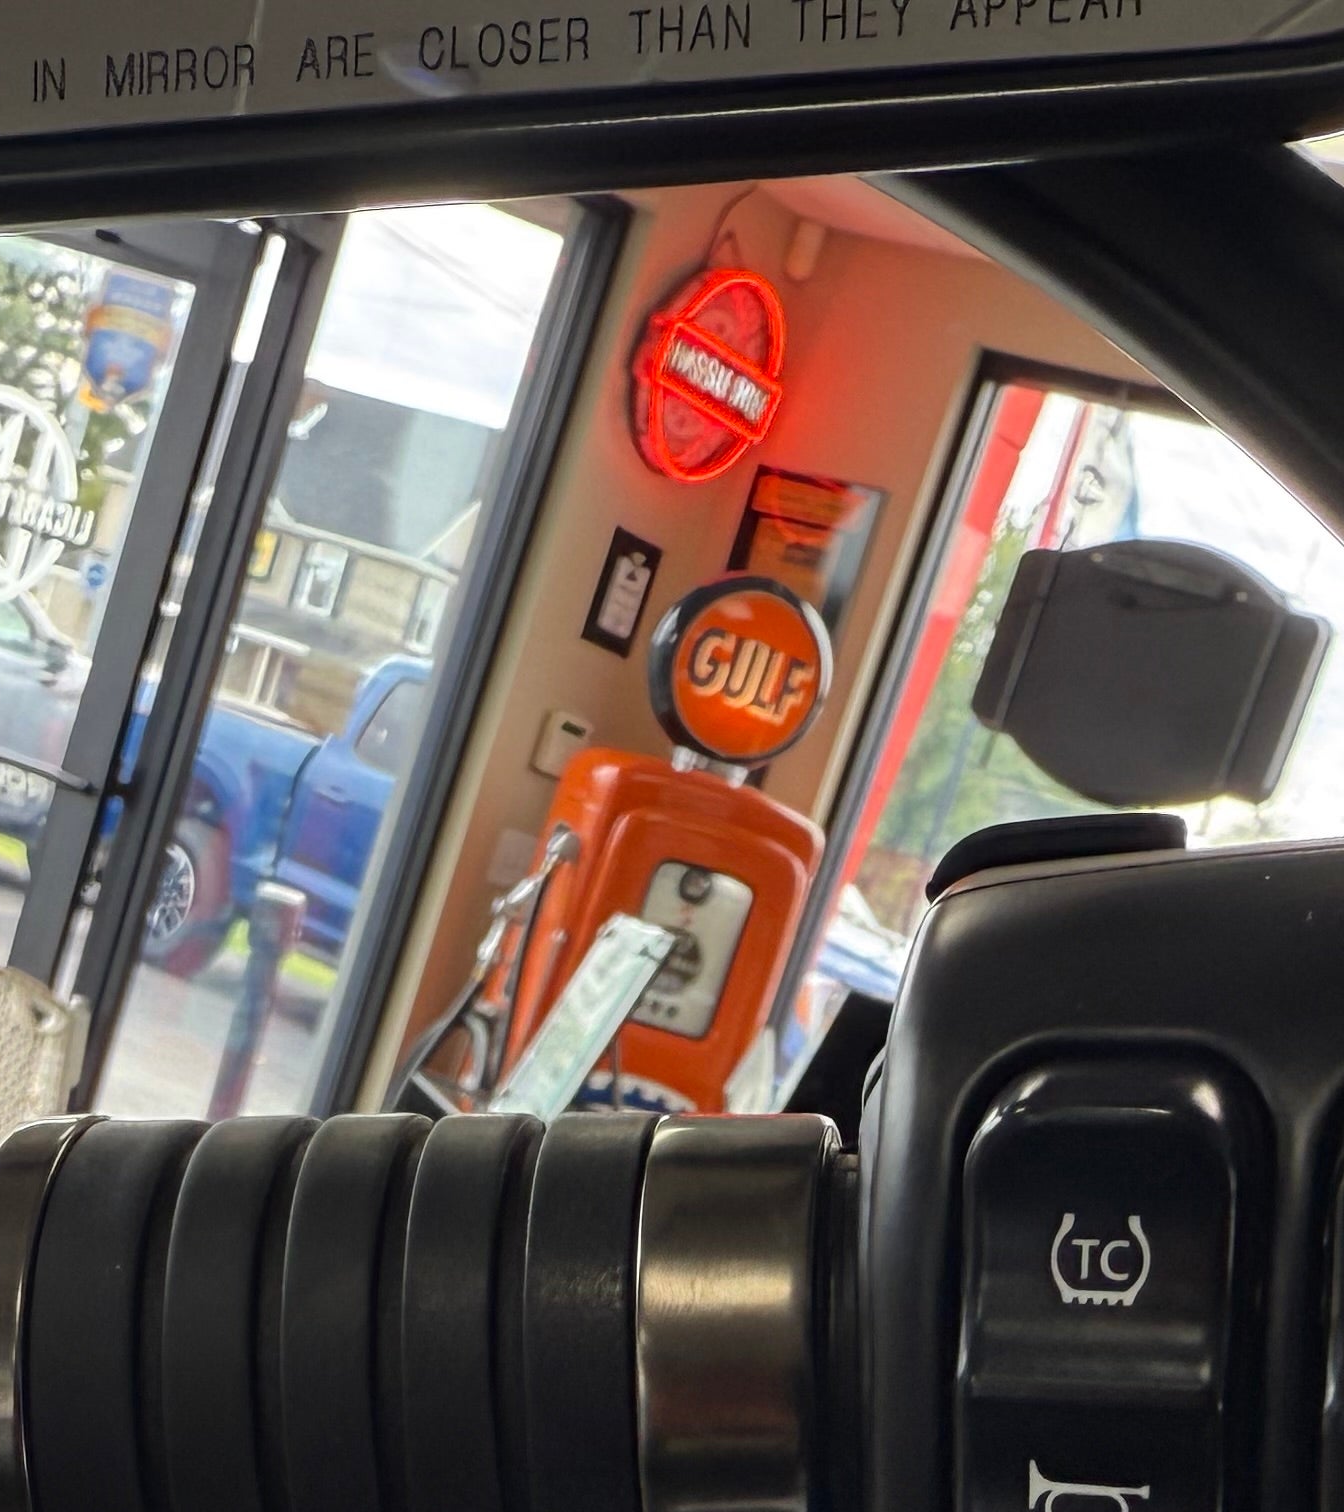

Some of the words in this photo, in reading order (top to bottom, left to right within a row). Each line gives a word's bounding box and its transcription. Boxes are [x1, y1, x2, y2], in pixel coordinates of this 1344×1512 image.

[32, 57, 67, 104] IN
[105, 43, 255, 98] MIRROR
[296, 32, 375, 83] ARE
[418, 16, 590, 71] CLOSER
[629, 3, 751, 54] THAN
[790, 0, 909, 43] THEY
[687, 627, 817, 726] GULF
[1071, 1238, 1131, 1282] TC
